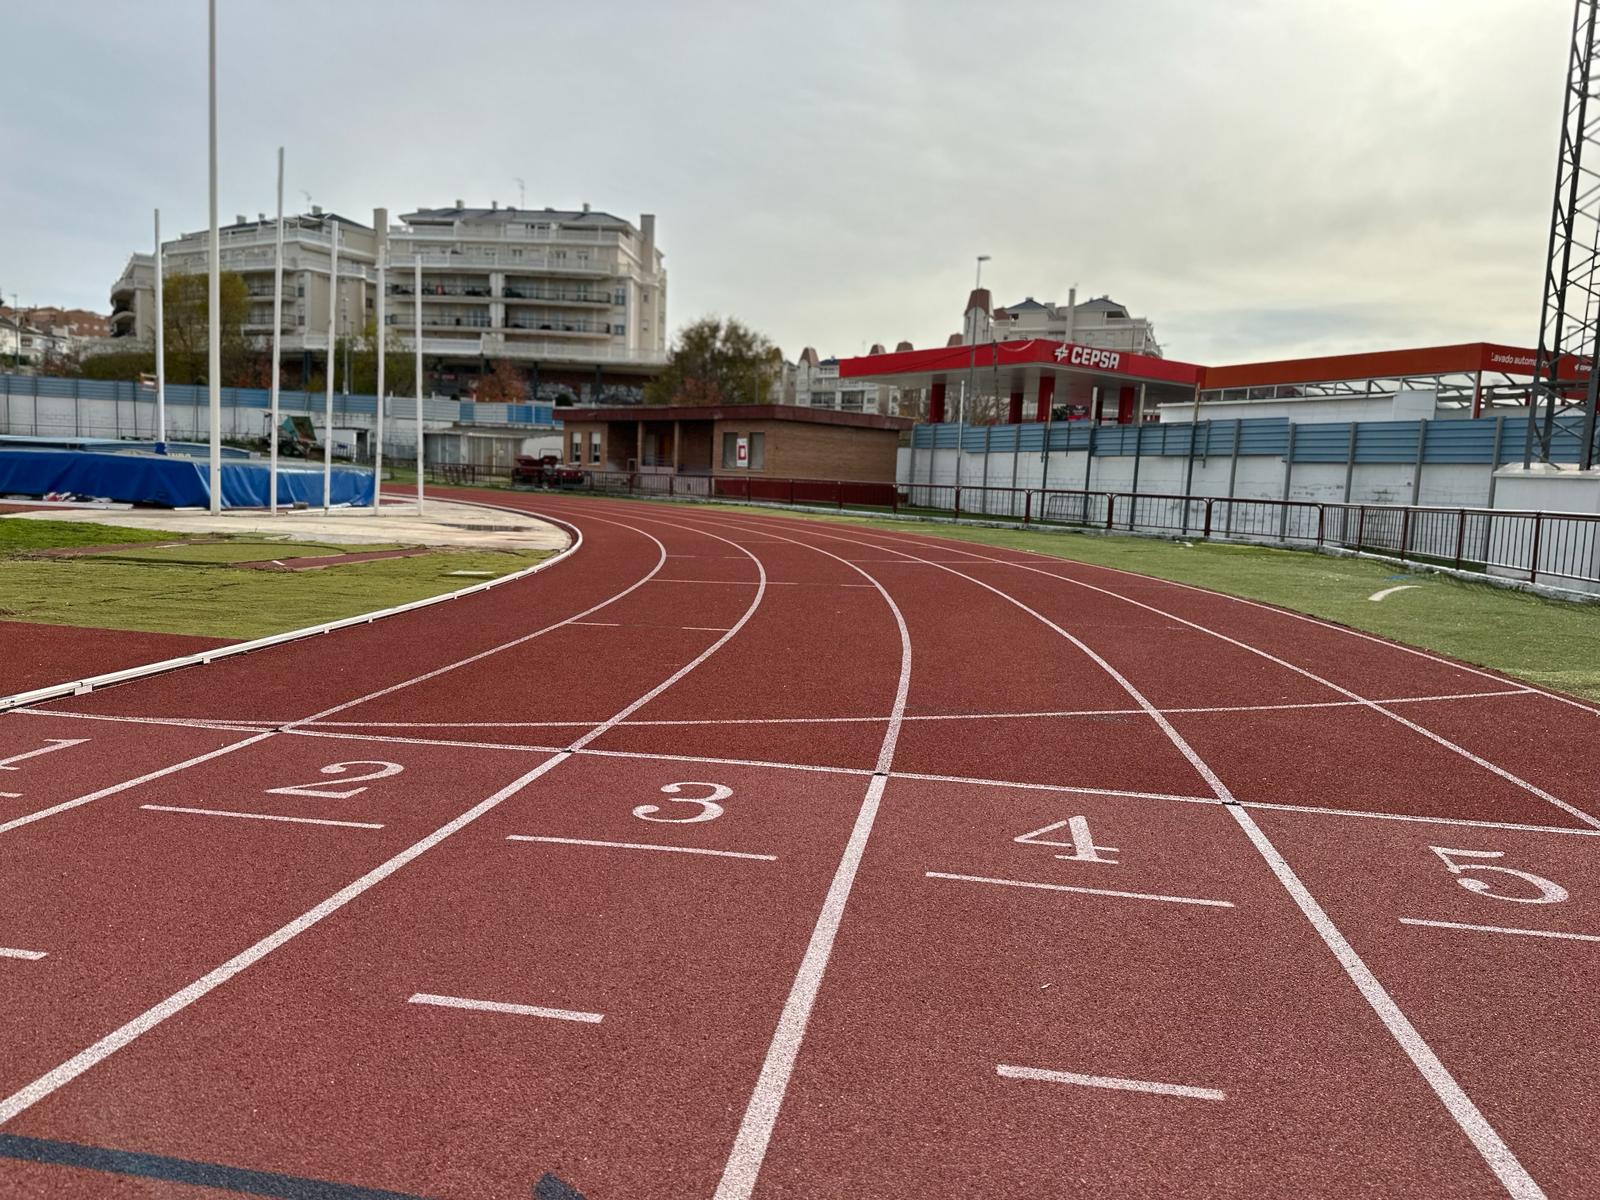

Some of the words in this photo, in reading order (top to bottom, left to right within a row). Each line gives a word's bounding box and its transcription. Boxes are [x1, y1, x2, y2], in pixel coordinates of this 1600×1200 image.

[1071, 346, 1120, 369] CEPSA
[264, 759, 404, 799] 2
[632, 781, 734, 823] 3
[1014, 815, 1120, 864] 4
[1428, 845, 1569, 904] 5
